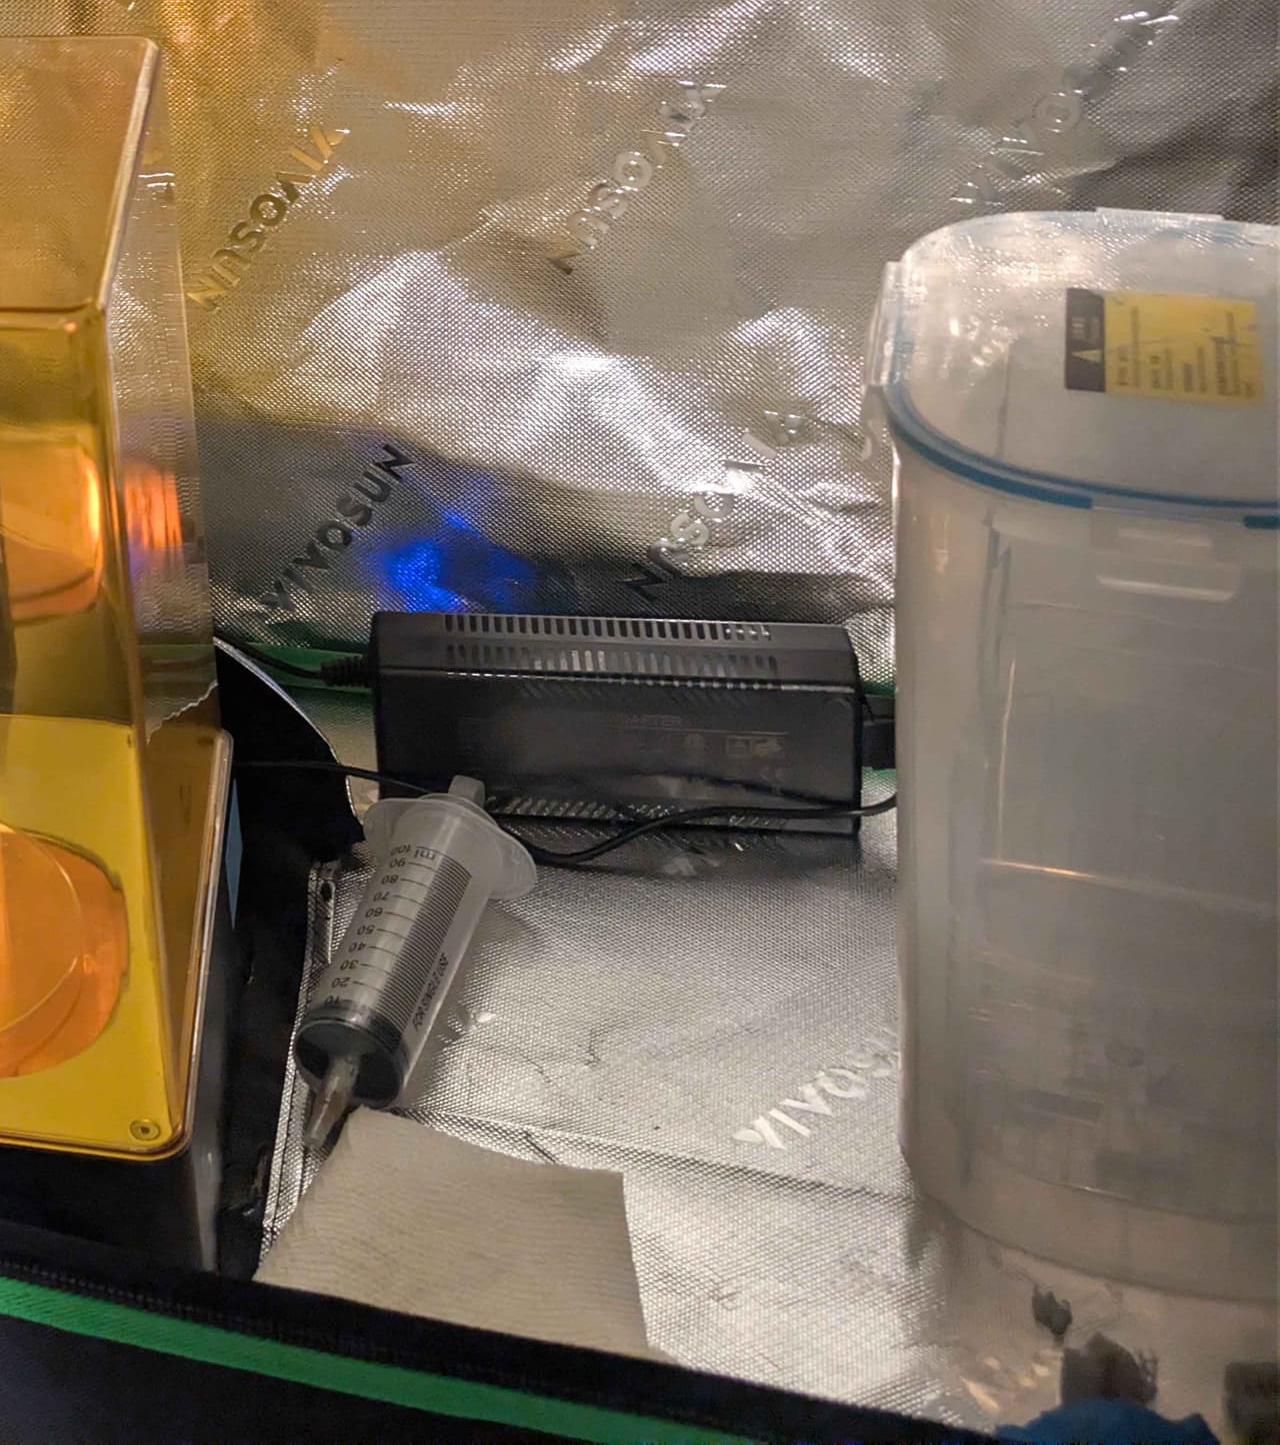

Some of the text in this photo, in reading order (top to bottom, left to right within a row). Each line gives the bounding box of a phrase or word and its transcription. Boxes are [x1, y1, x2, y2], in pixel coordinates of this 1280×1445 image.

[185, 124, 352, 314] VIVOSUN
[260, 442, 416, 614] VIVOSUN
[389, 858, 407, 868] 90
[381, 874, 399, 885] 80
[373, 891, 390, 902] 70
[365, 907, 384, 918] 60
[357, 925, 376, 936] 50
[349, 942, 367, 953] 40
[340, 959, 359, 970] 30
[331, 977, 351, 988] 20
[732, 1026, 898, 1152] VIVOS
